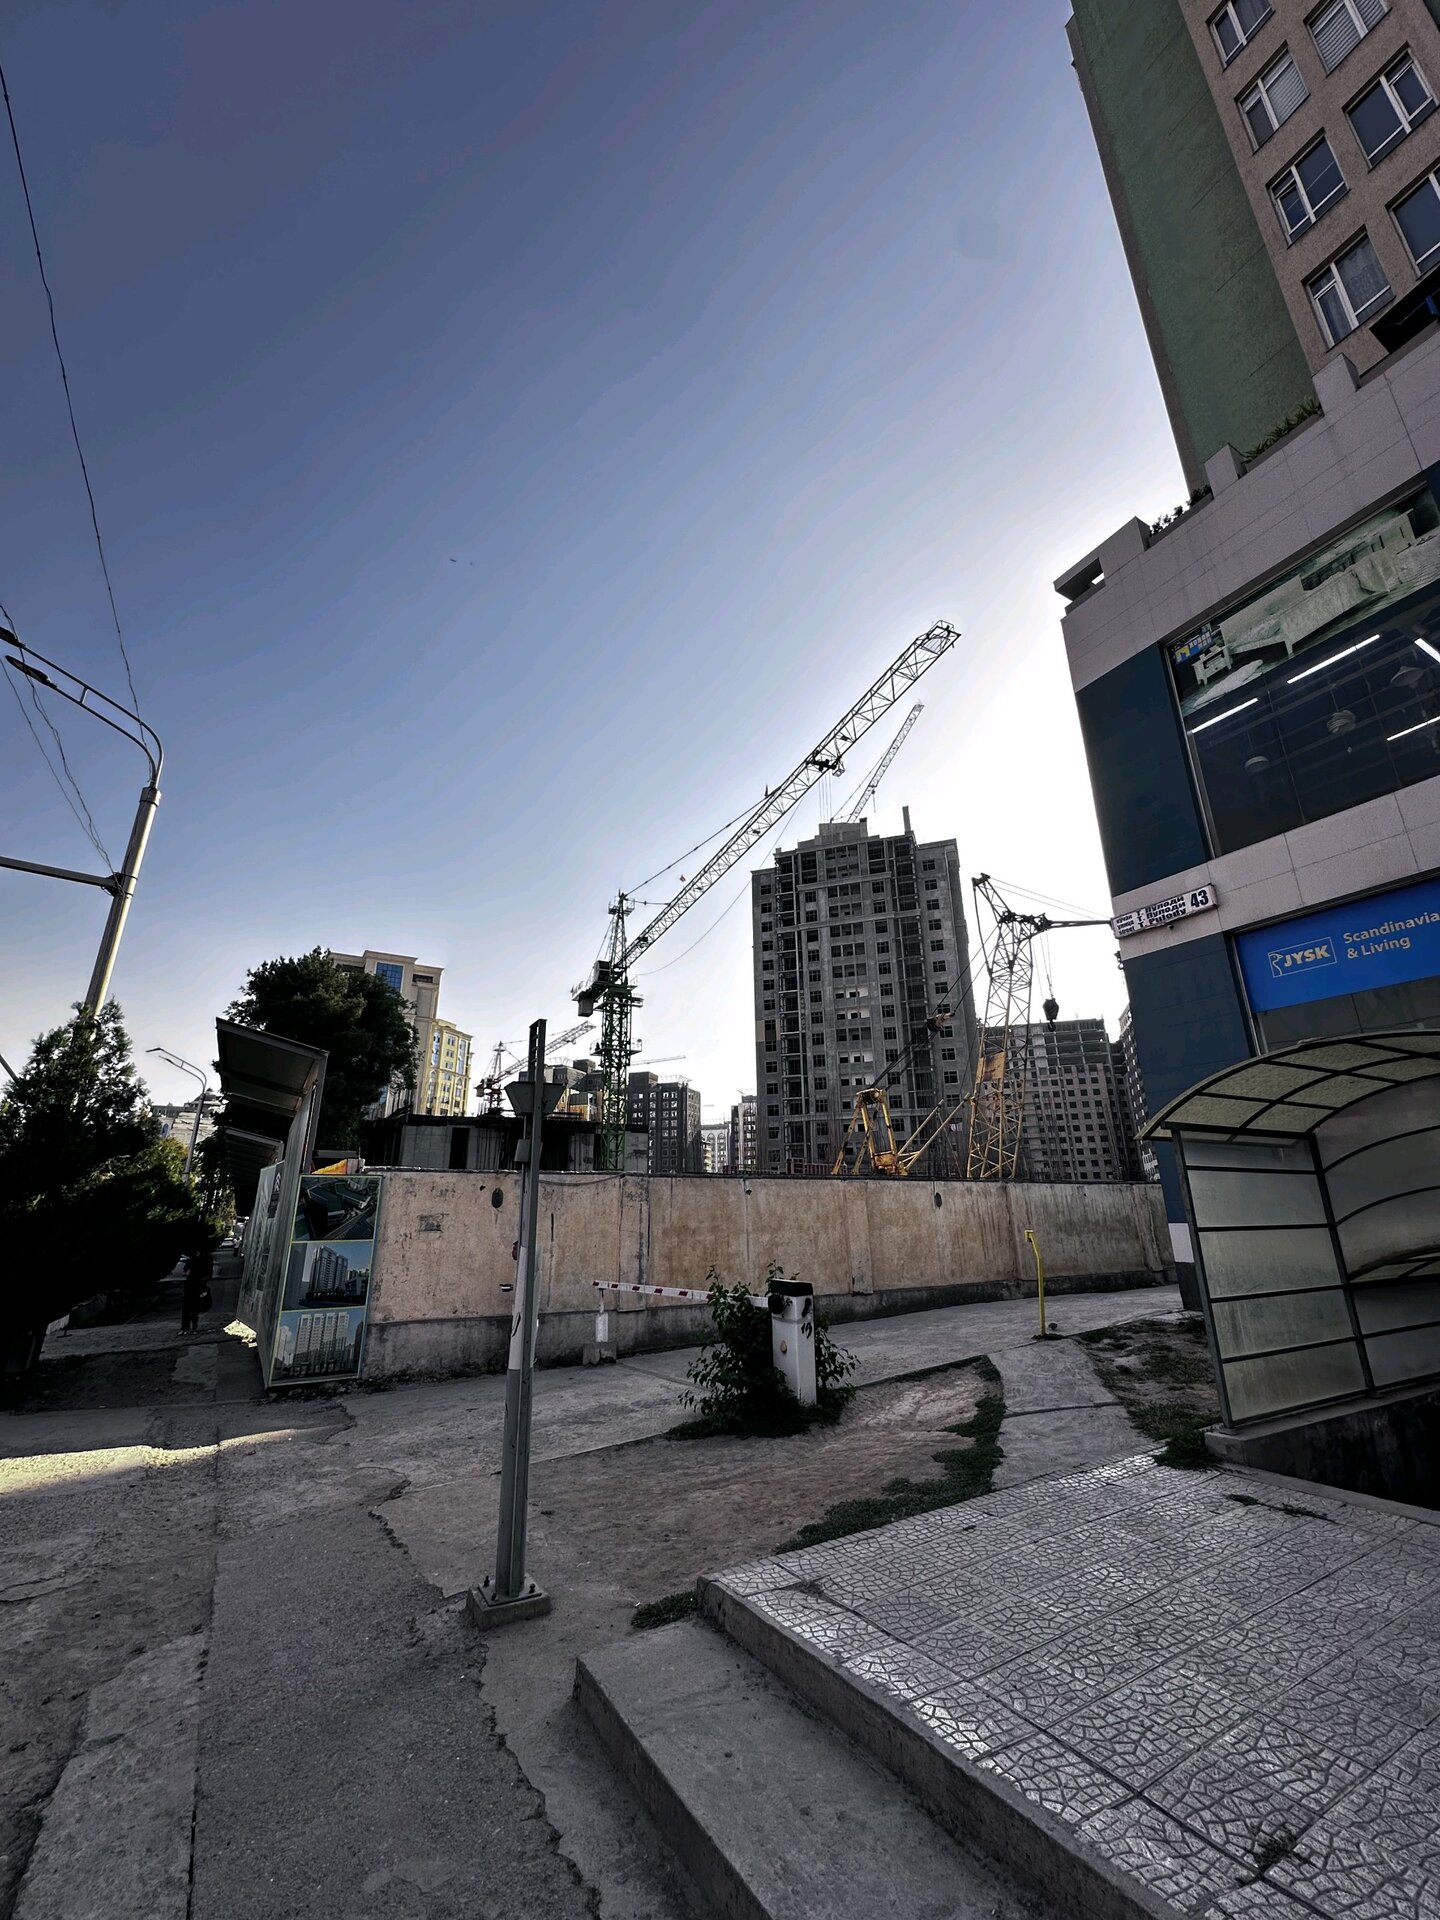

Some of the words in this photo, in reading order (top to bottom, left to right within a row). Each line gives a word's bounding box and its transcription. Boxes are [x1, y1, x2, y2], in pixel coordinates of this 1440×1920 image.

[1190, 889, 1209, 908] 43
[1146, 901, 1186, 919] Пулоди
[1148, 908, 1187, 925] Pulody
[1284, 944, 1331, 968] JYSK
[1346, 948, 1359, 959] &
[1361, 936, 1411, 957] Living
